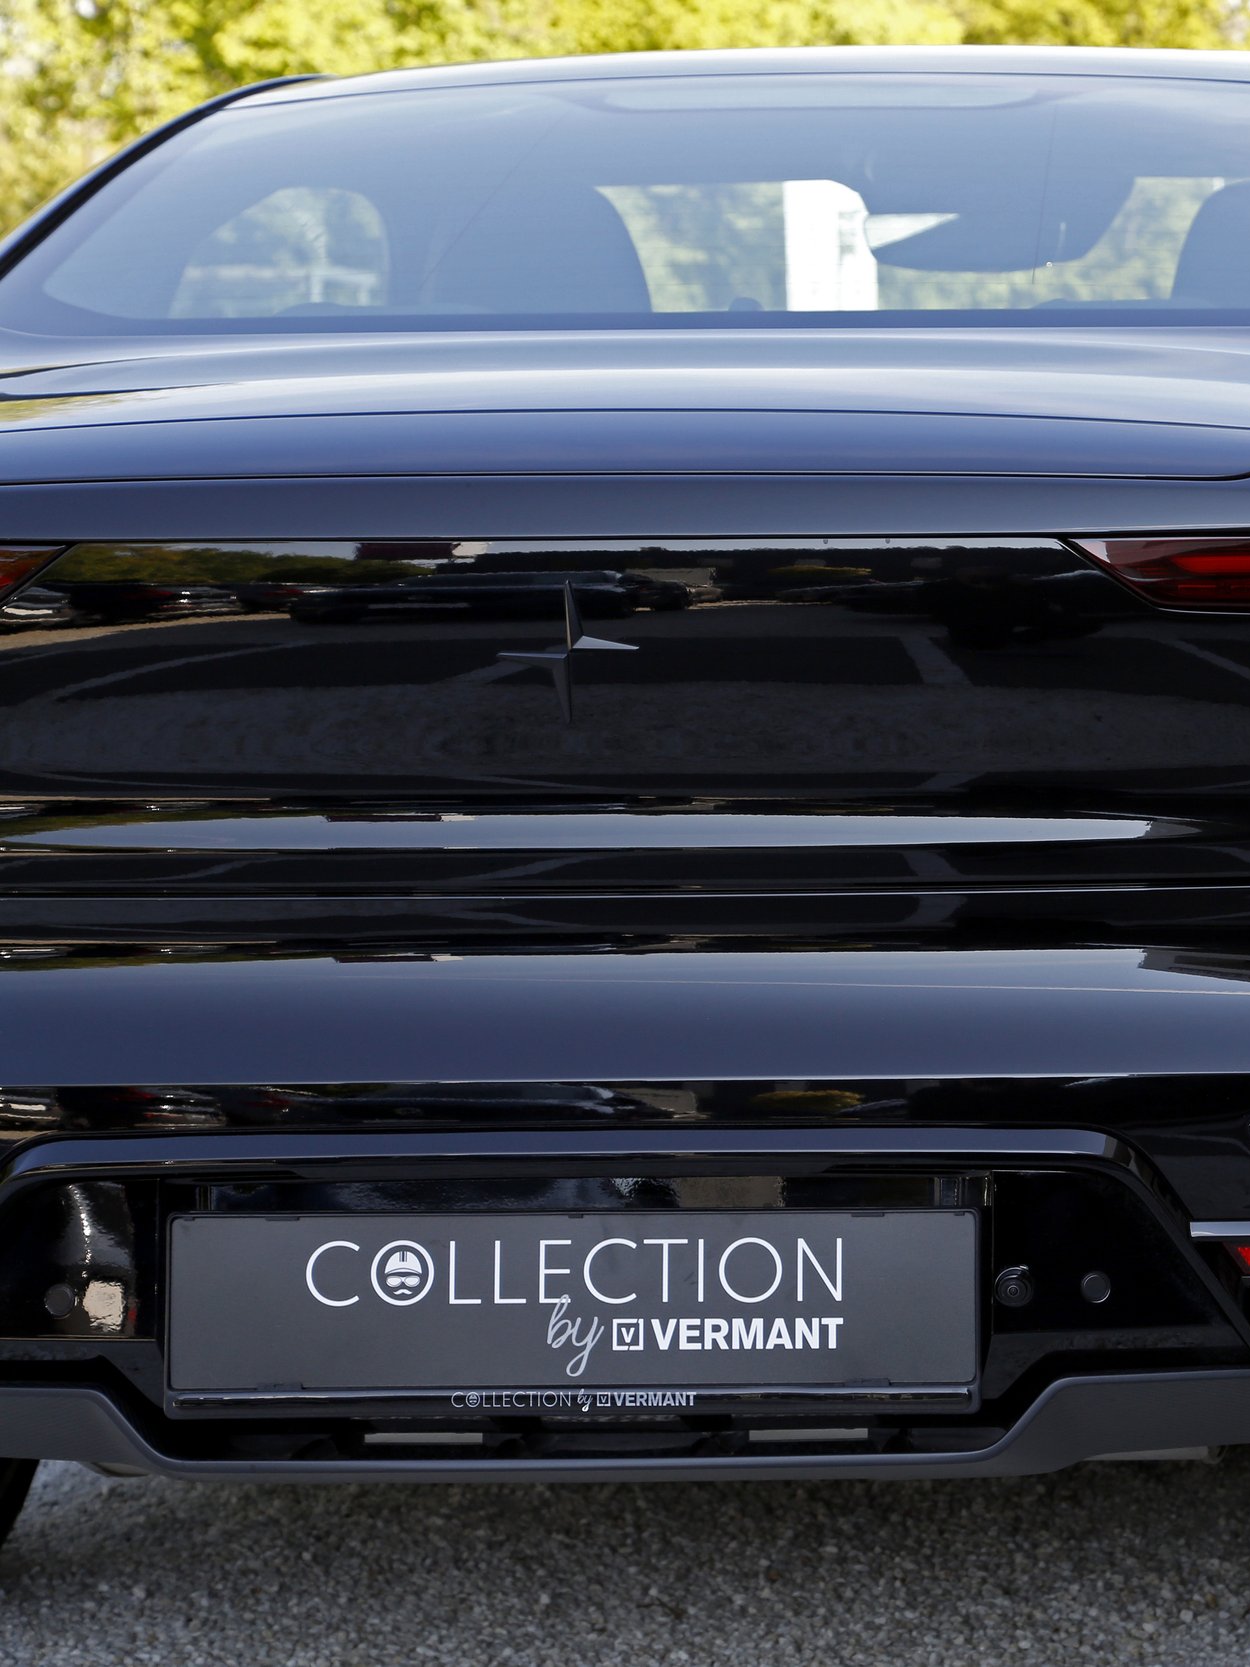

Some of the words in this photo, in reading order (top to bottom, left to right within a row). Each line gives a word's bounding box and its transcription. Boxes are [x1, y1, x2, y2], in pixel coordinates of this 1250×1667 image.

[305, 1237, 843, 1306] COLLECTION
[546, 1294, 605, 1377] by
[651, 1317, 844, 1351] VERMANT
[451, 1391, 571, 1408] COLLECTION
[577, 1388, 593, 1412] by
[613, 1391, 697, 1407] VERMANT
